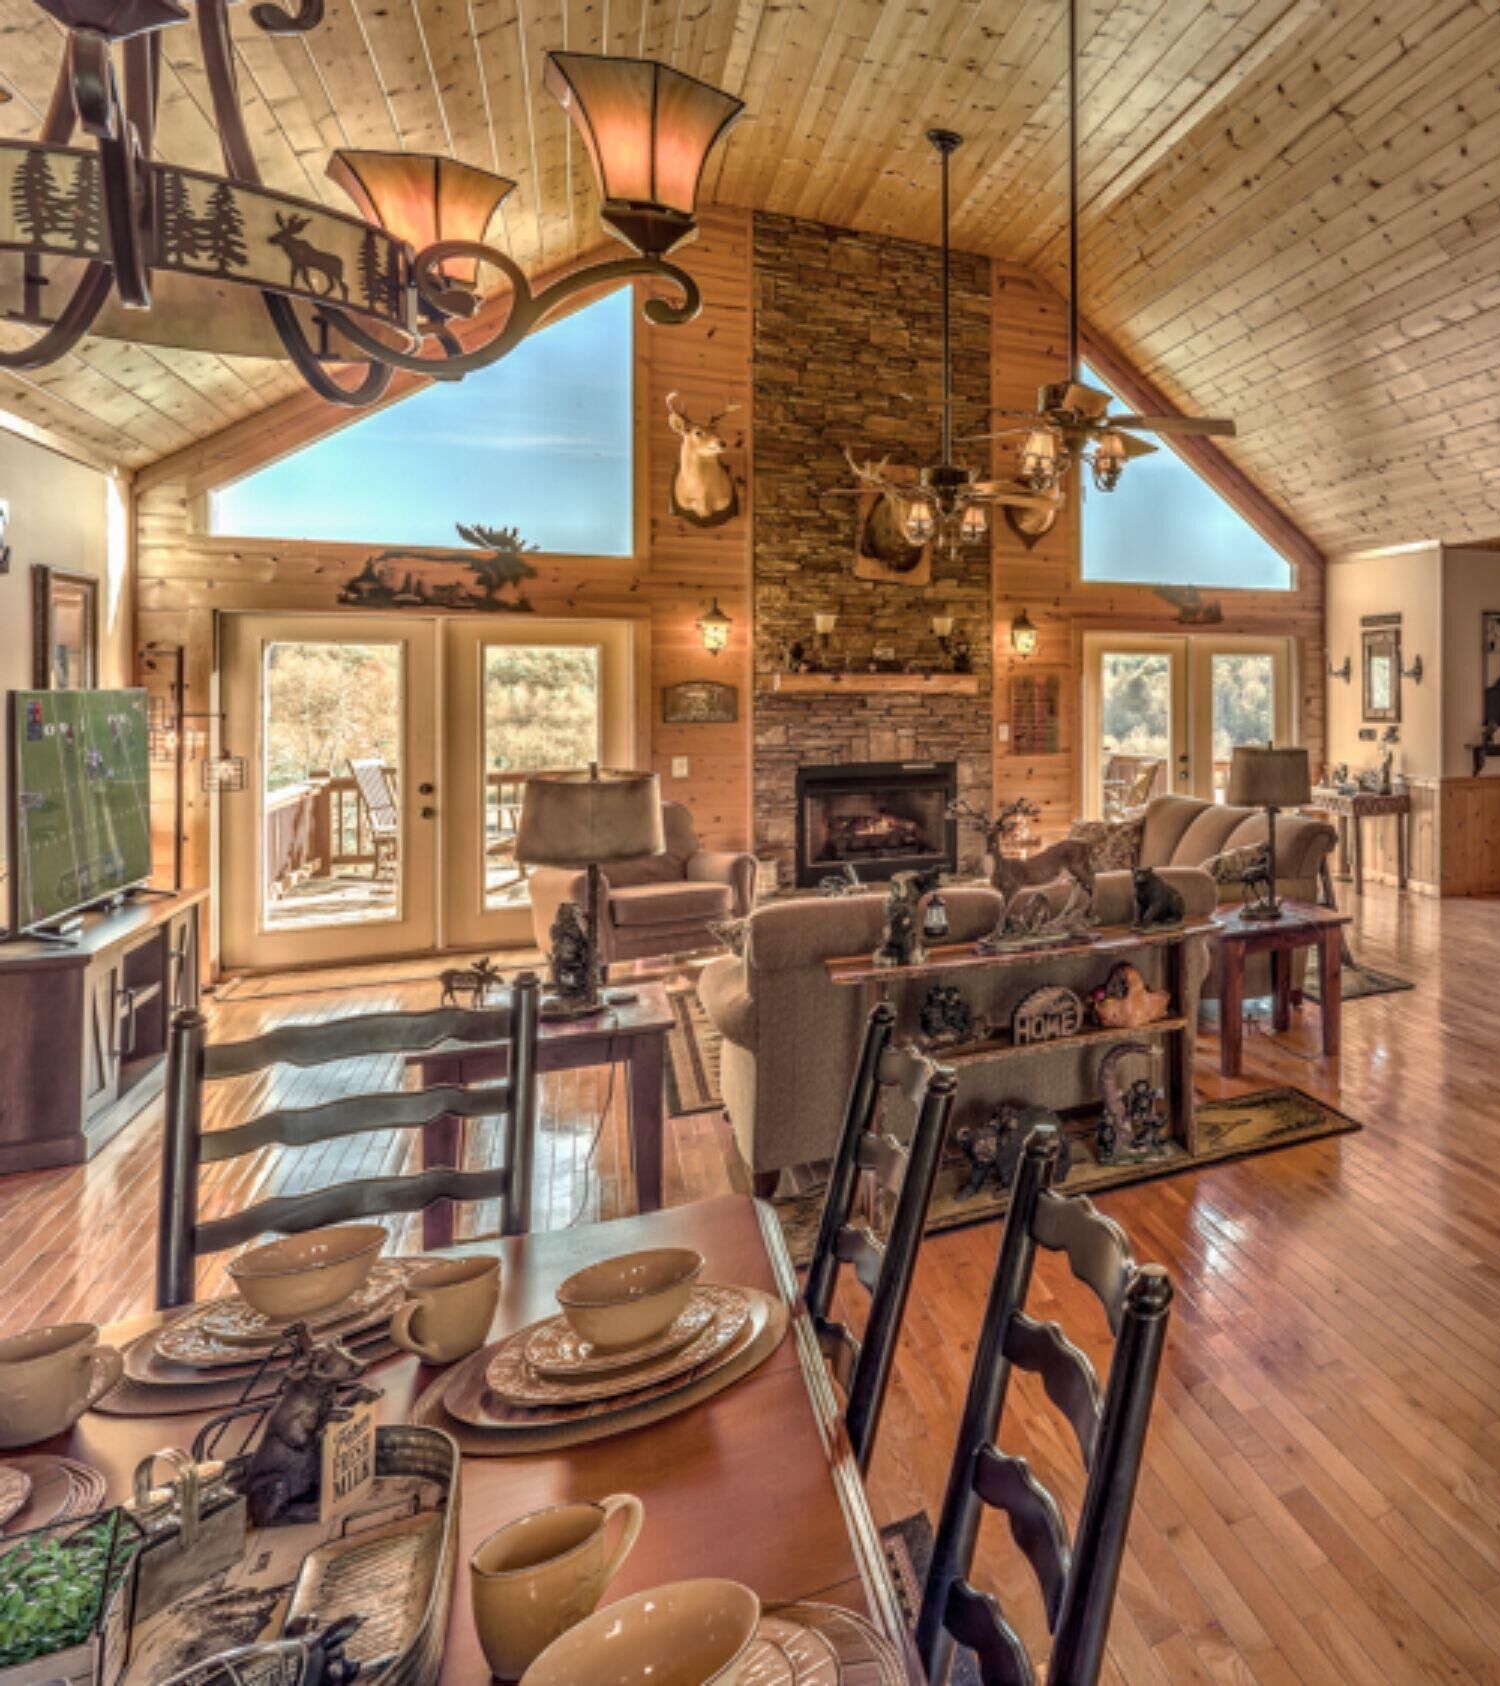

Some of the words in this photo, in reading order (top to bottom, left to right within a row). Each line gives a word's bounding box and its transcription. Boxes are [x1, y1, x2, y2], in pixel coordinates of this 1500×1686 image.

[1014, 1010, 1074, 1044] HOME
[333, 1432, 371, 1481] FRESH
[333, 1457, 371, 1503] MILK
